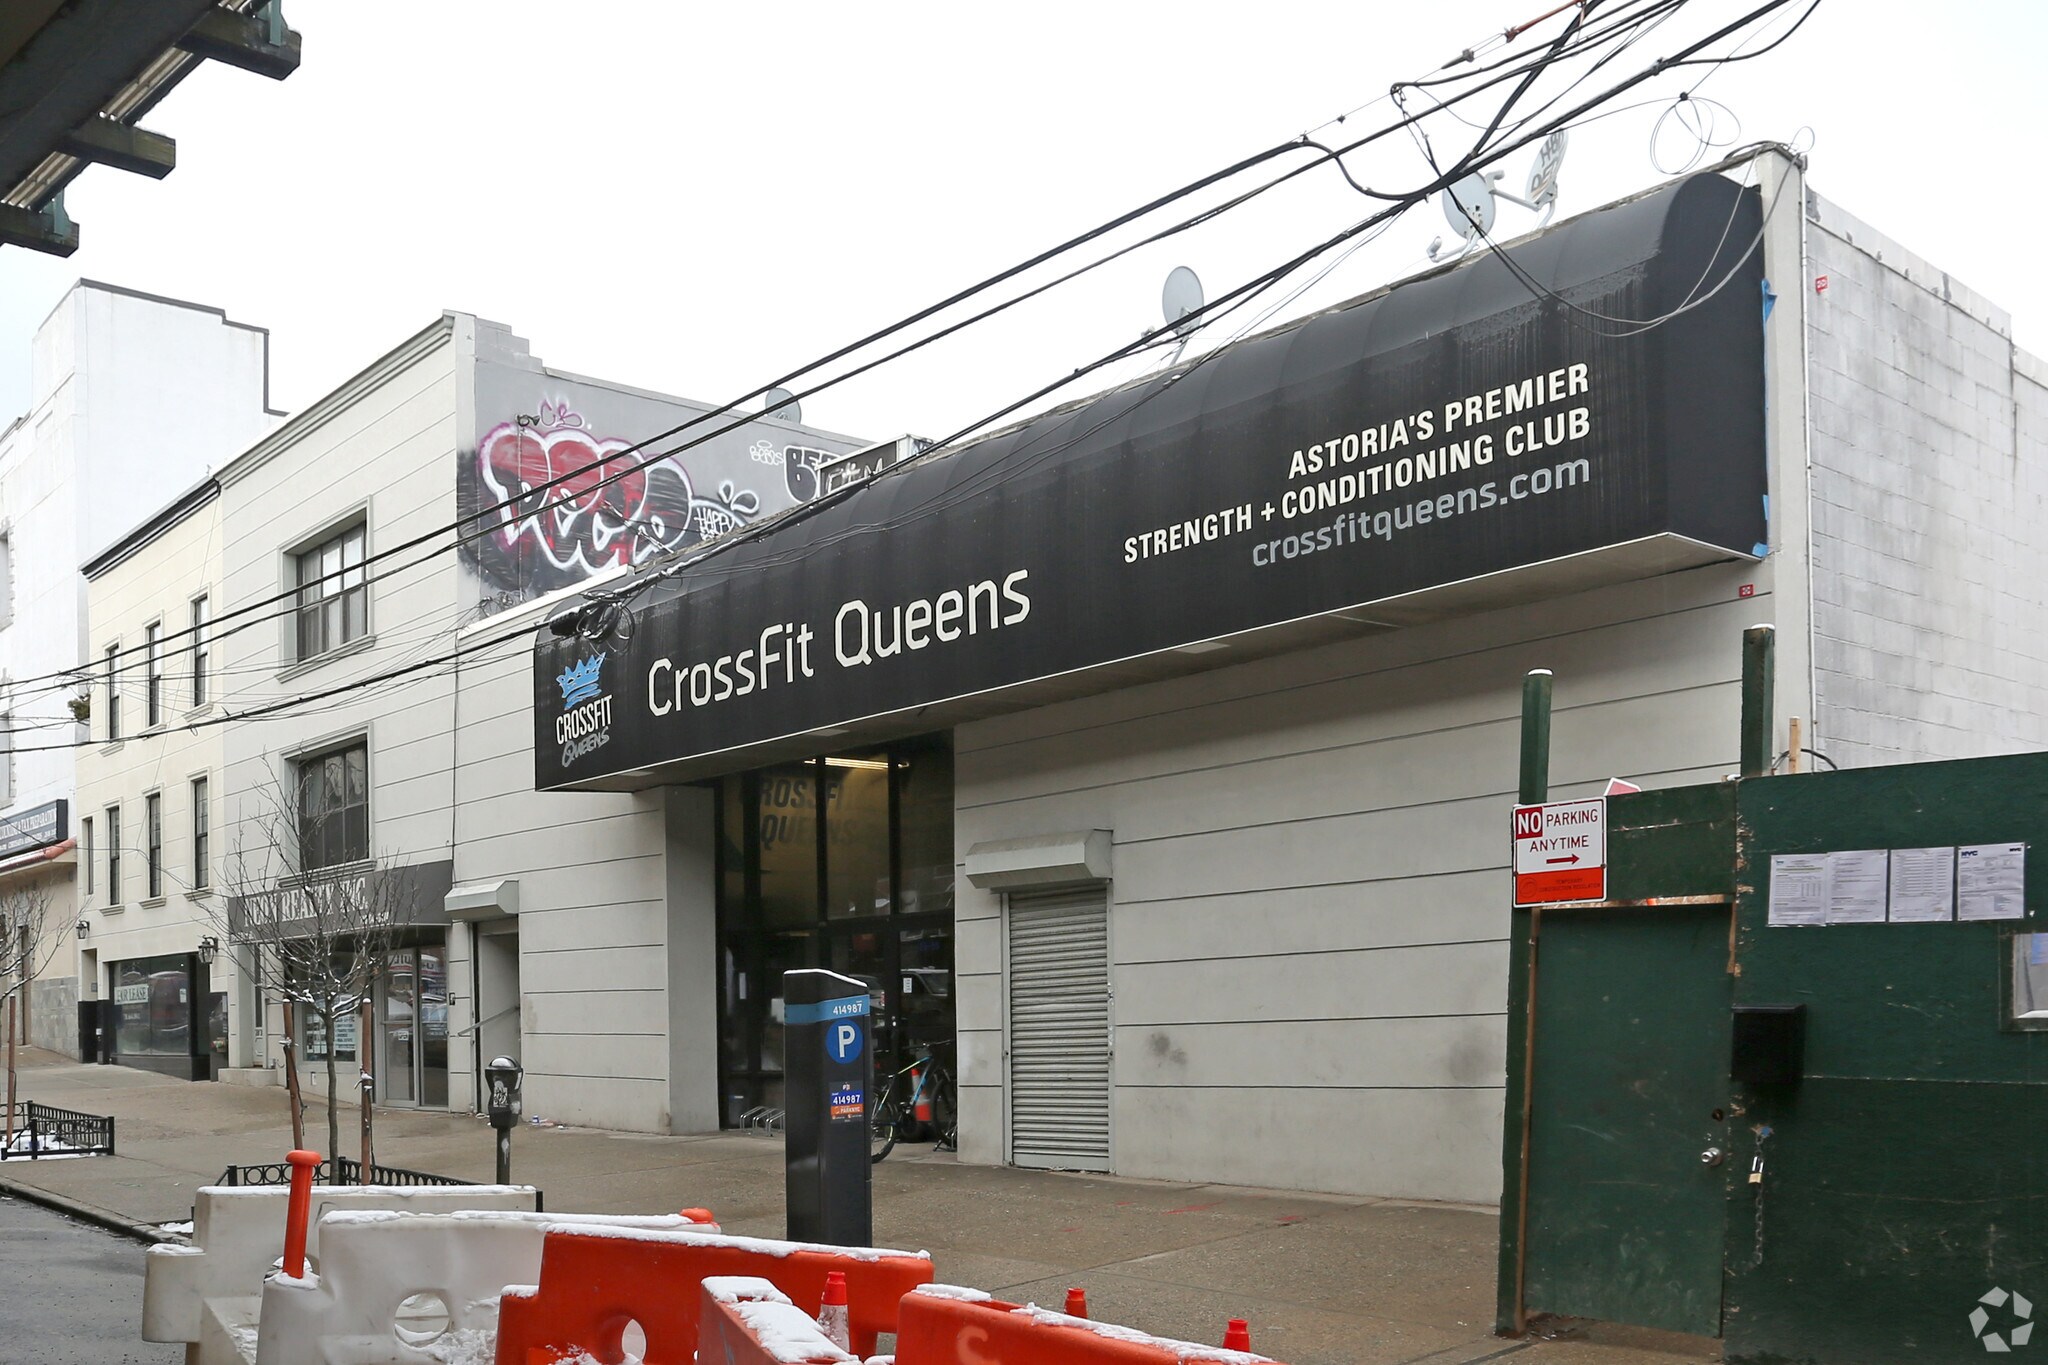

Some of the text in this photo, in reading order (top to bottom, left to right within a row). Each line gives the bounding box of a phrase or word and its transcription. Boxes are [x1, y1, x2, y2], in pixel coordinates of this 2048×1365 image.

[1288, 363, 1589, 480] ASTORIA'S PREMIER
[1123, 407, 1591, 564] STRENGTH + CONDITIONING CLUB
[1252, 458, 1591, 567] crossfitqueens.com
[648, 569, 1031, 717] CrossFit Queens
[555, 694, 613, 745] CROSSFIT
[1517, 809, 1598, 835] NO PARKING
[1529, 835, 1589, 852] ANYTIME
[832, 1003, 862, 1015] 414987
[838, 1025, 855, 1057] P
[833, 1095, 861, 1105] 414987
